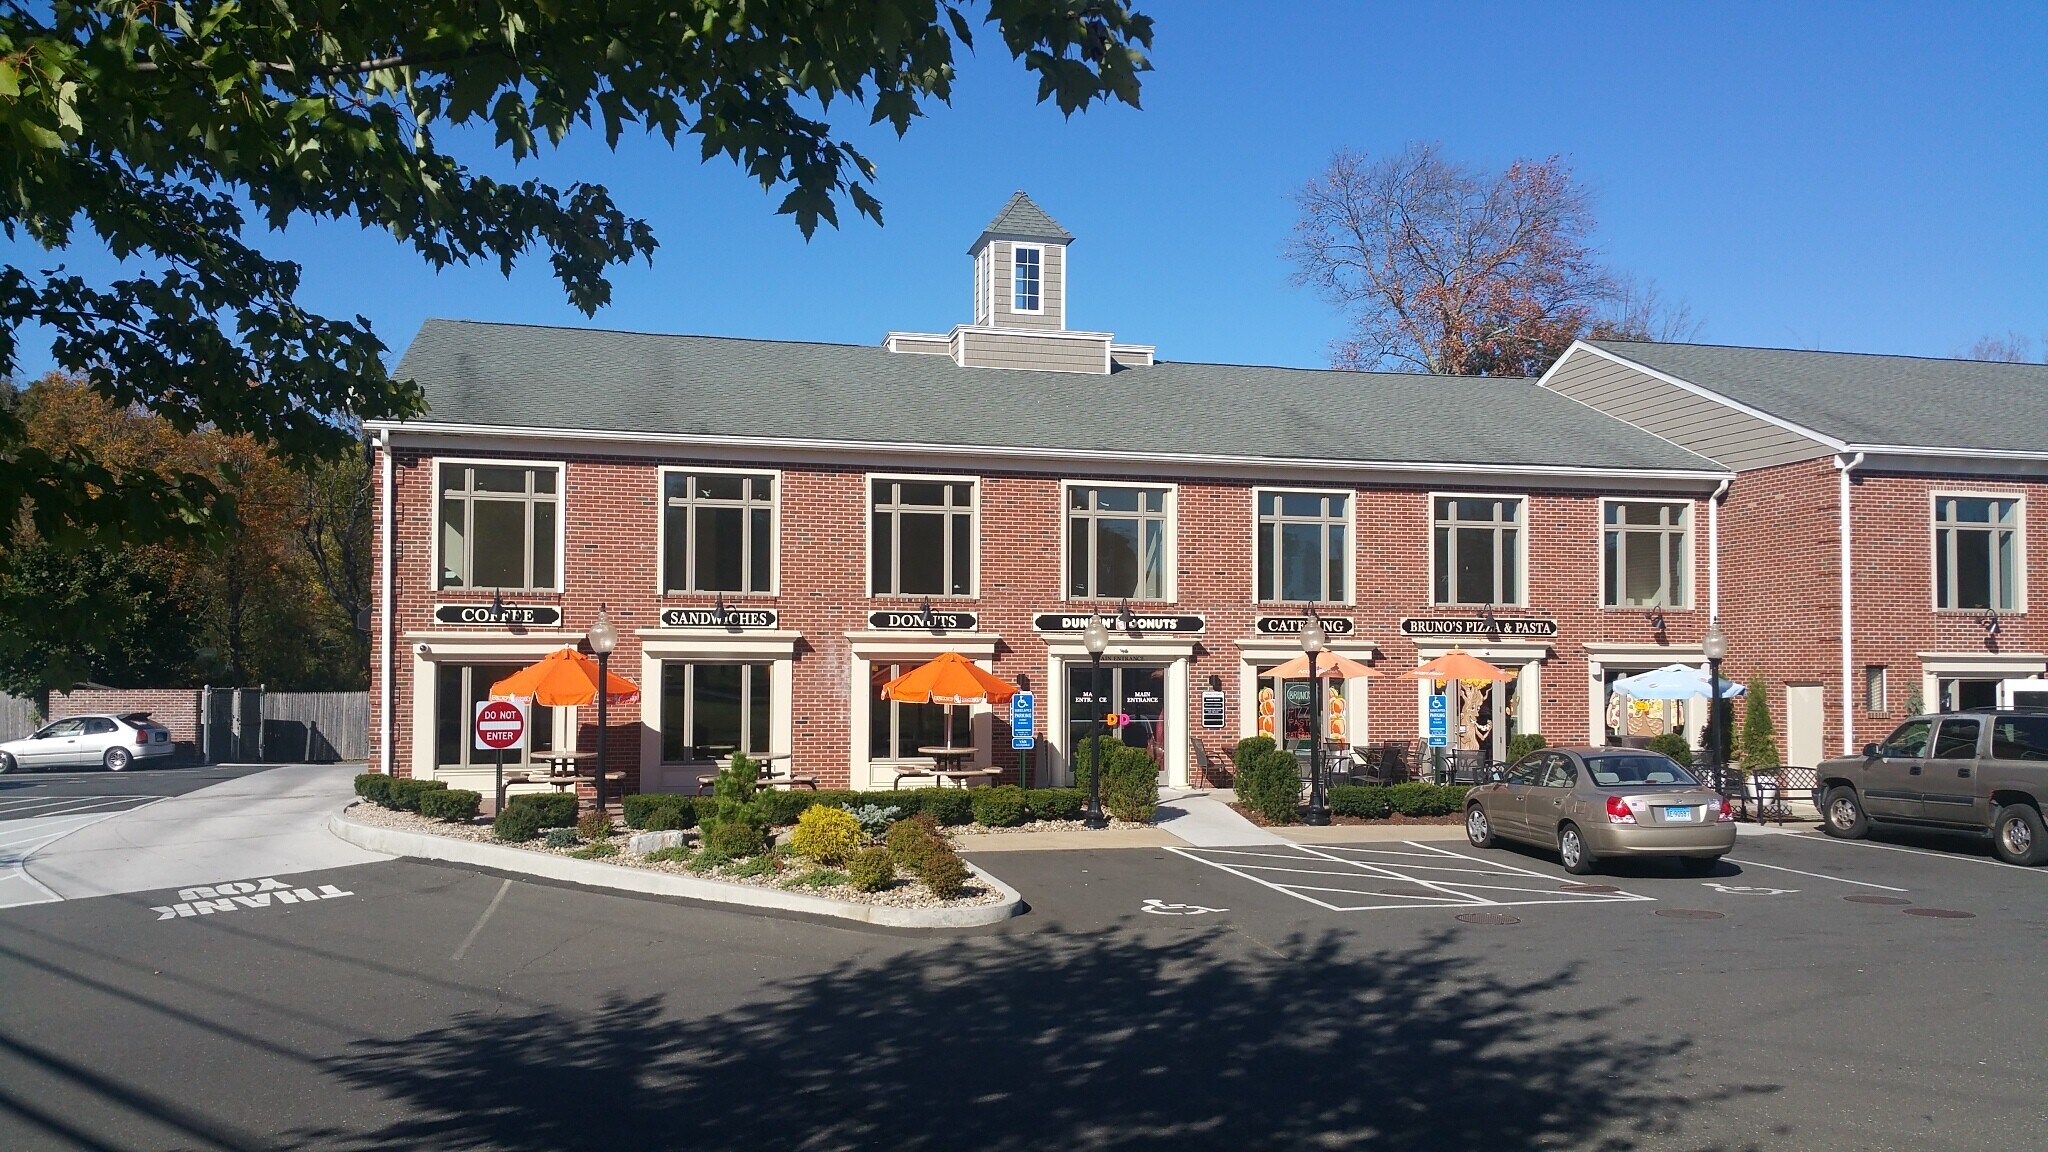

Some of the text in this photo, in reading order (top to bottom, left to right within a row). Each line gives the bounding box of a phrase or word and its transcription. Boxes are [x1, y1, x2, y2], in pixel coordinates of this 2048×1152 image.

[888, 614, 957, 628] DONUTS
[1061, 617, 1114, 629] DUNN'
[1267, 619, 1344, 632] CATENG
[1410, 620, 1463, 633] BRUNO'S
[1503, 622, 1513, 633] &
[1515, 622, 1552, 634] PASTA
[484, 710, 516, 720] DO NOT
[486, 731, 514, 741] ENTER
[177, 878, 293, 901] YOU
[150, 884, 354, 921] THANK
